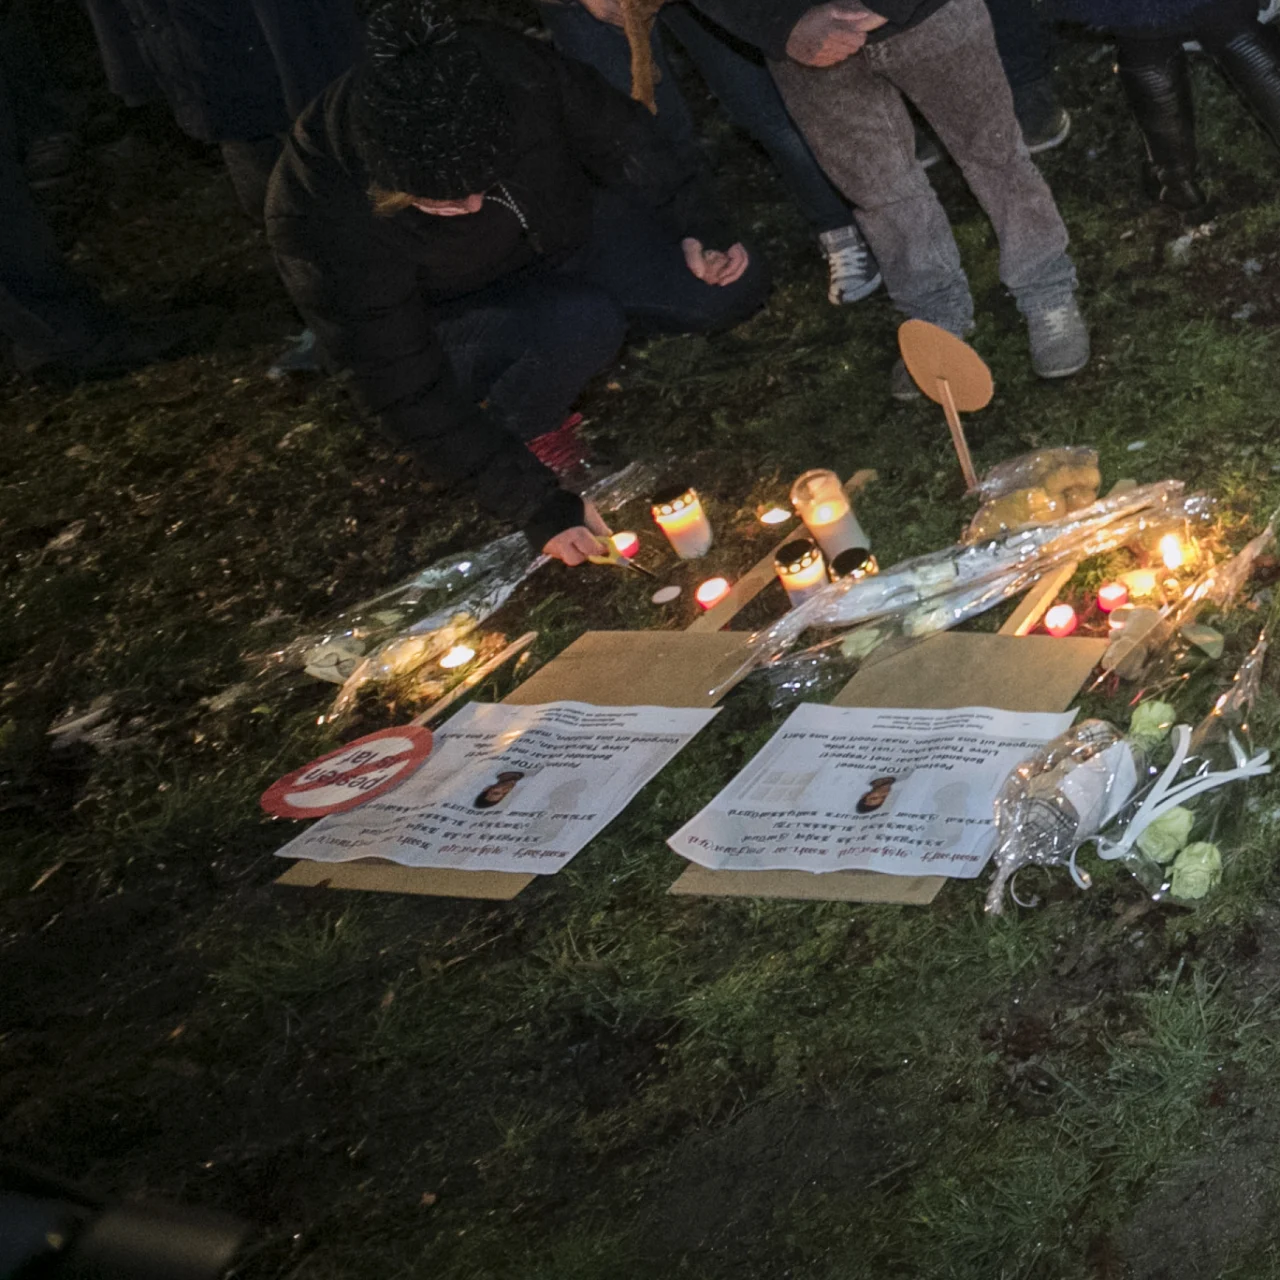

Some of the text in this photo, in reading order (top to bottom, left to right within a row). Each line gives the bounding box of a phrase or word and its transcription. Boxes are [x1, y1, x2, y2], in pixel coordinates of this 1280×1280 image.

[335, 750, 394, 773] is laf
[930, 754, 985, 764] Behandel
[303, 769, 387, 791] pesten
